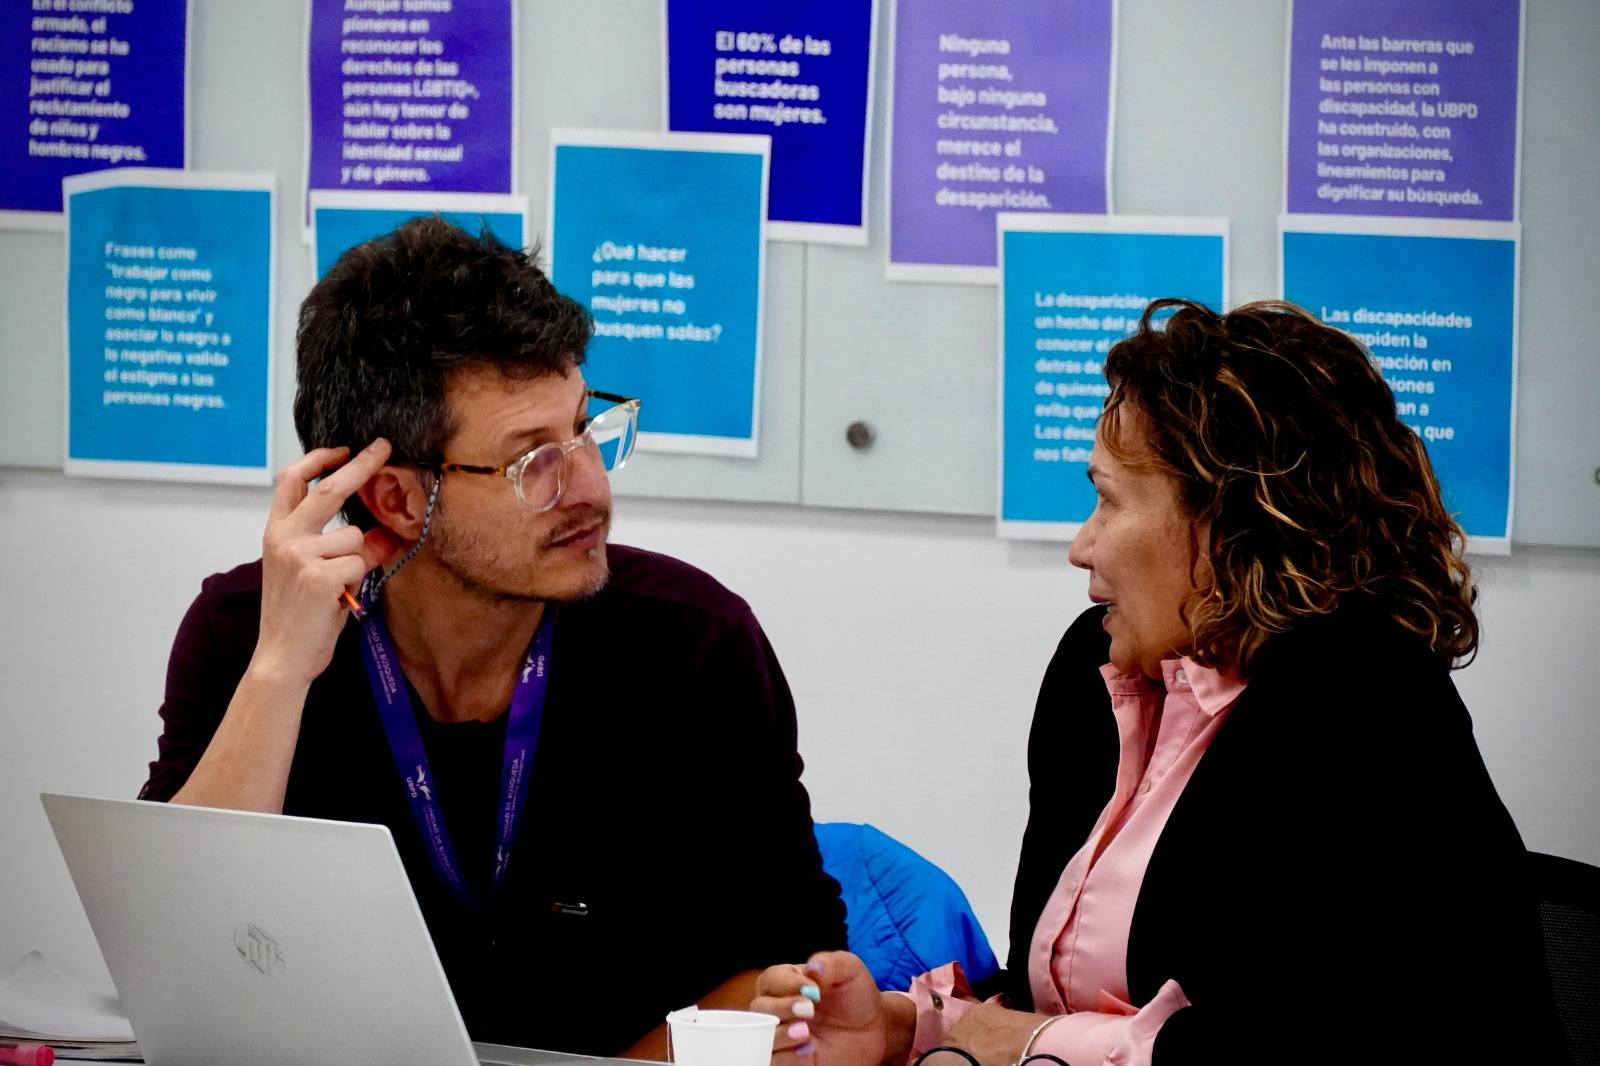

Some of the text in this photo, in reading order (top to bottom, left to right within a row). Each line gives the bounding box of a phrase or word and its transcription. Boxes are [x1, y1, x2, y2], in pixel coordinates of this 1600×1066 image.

[31, 15, 107, 34] armado, el
[342, 15, 429, 35] pioneros en
[31, 35, 129, 55] racismo se ha
[341, 37, 444, 55] reconocer los
[736, 32, 831, 56] 60% de las
[939, 34, 1010, 57] Ninguna
[1321, 34, 1474, 57] Ante las barreras que
[31, 57, 110, 78] usado para
[341, 57, 459, 77] derechos de las
[715, 58, 799, 78] personas
[938, 63, 1013, 81] persona,
[1320, 56, 1438, 76] se les imponen a
[29, 75, 111, 97] justificar el
[342, 81, 412, 99] personas
[714, 79, 819, 101] buscadoras
[1320, 76, 1440, 96] las personas con
[937, 85, 1047, 109] bajo ninguna
[30, 97, 131, 118] reclutamiento
[372, 100, 399, 121] hay
[401, 101, 447, 119] temor
[448, 101, 469, 120] de
[713, 101, 827, 126] son mujeres.
[1319, 97, 1478, 119] discapacidad, la UBPD
[29, 117, 100, 141] de niños y
[343, 120, 451, 140] hablar sobre la
[937, 110, 1058, 135] circunstancia,
[1318, 119, 1451, 139] ha construido, con
[29, 138, 148, 163] hombres negros.
[343, 142, 463, 161] identidad sexual
[936, 138, 1021, 157] merece el
[1317, 140, 1453, 162] las organizaciones,
[341, 167, 351, 184] y
[352, 164, 372, 181] de
[936, 161, 1044, 183] destino de la
[1317, 161, 1445, 184] lineamientos para
[935, 187, 1052, 210] desaparición.
[1317, 183, 1482, 206] dignificar su búsqueda.
[105, 241, 197, 261] Frases como
[592, 240, 686, 263] ¿Qué hacer
[171, 268, 213, 283] como
[591, 270, 695, 290] para que las
[105, 286, 147, 303] negro
[150, 288, 182, 303] para
[591, 293, 686, 315] mujeres no
[1034, 291, 1054, 308] La
[105, 307, 145, 321] como
[205, 312, 214, 328] y
[1034, 316, 1054, 330] un
[1055, 313, 1099, 331] hecho
[1101, 315, 1125, 331] del
[1321, 306, 1472, 329] Las discapacidades
[105, 328, 231, 348] asociar lo negro a
[666, 323, 722, 341] solas?
[1413, 333, 1428, 349] la
[1095, 337, 1110, 353] el
[105, 347, 118, 362] lo
[121, 348, 182, 366] negativo
[1432, 358, 1452, 372] en
[104, 367, 214, 387] el estigma a las
[1034, 379, 1055, 396] de
[103, 390, 170, 407] personas
[1419, 402, 1429, 417] a
[1424, 425, 1455, 442] que
[536, 655, 545, 677] UBPD
[406, 776, 418, 798] UBPD
